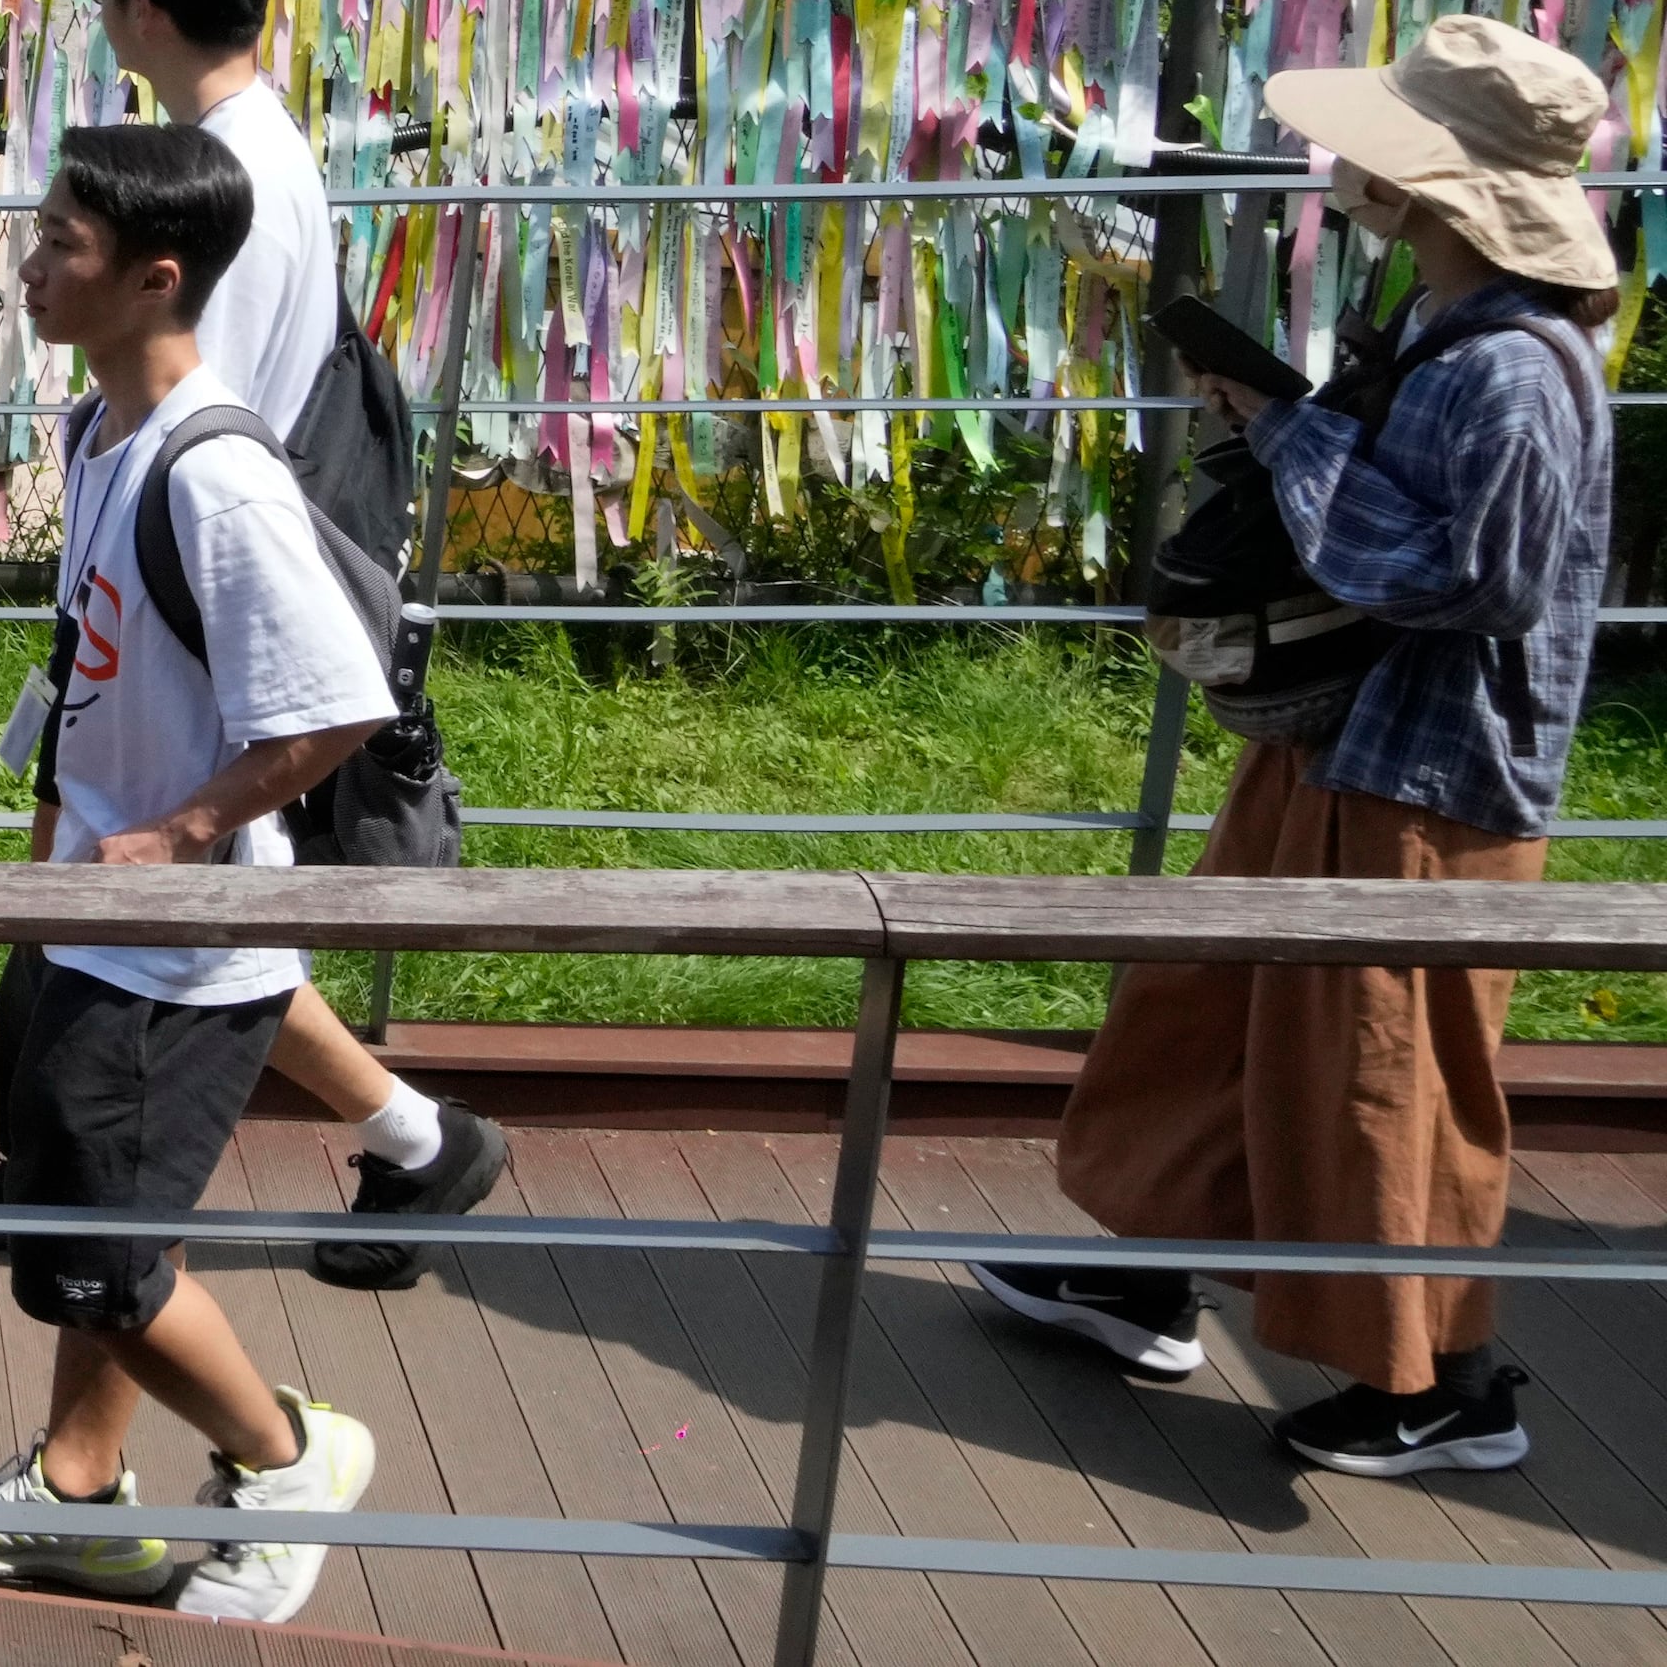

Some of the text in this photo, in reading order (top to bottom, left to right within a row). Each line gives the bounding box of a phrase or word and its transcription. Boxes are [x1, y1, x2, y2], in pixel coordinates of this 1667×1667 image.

[558, 220, 571, 241] End
[564, 254, 577, 291] Korean
[567, 292, 577, 313] War
